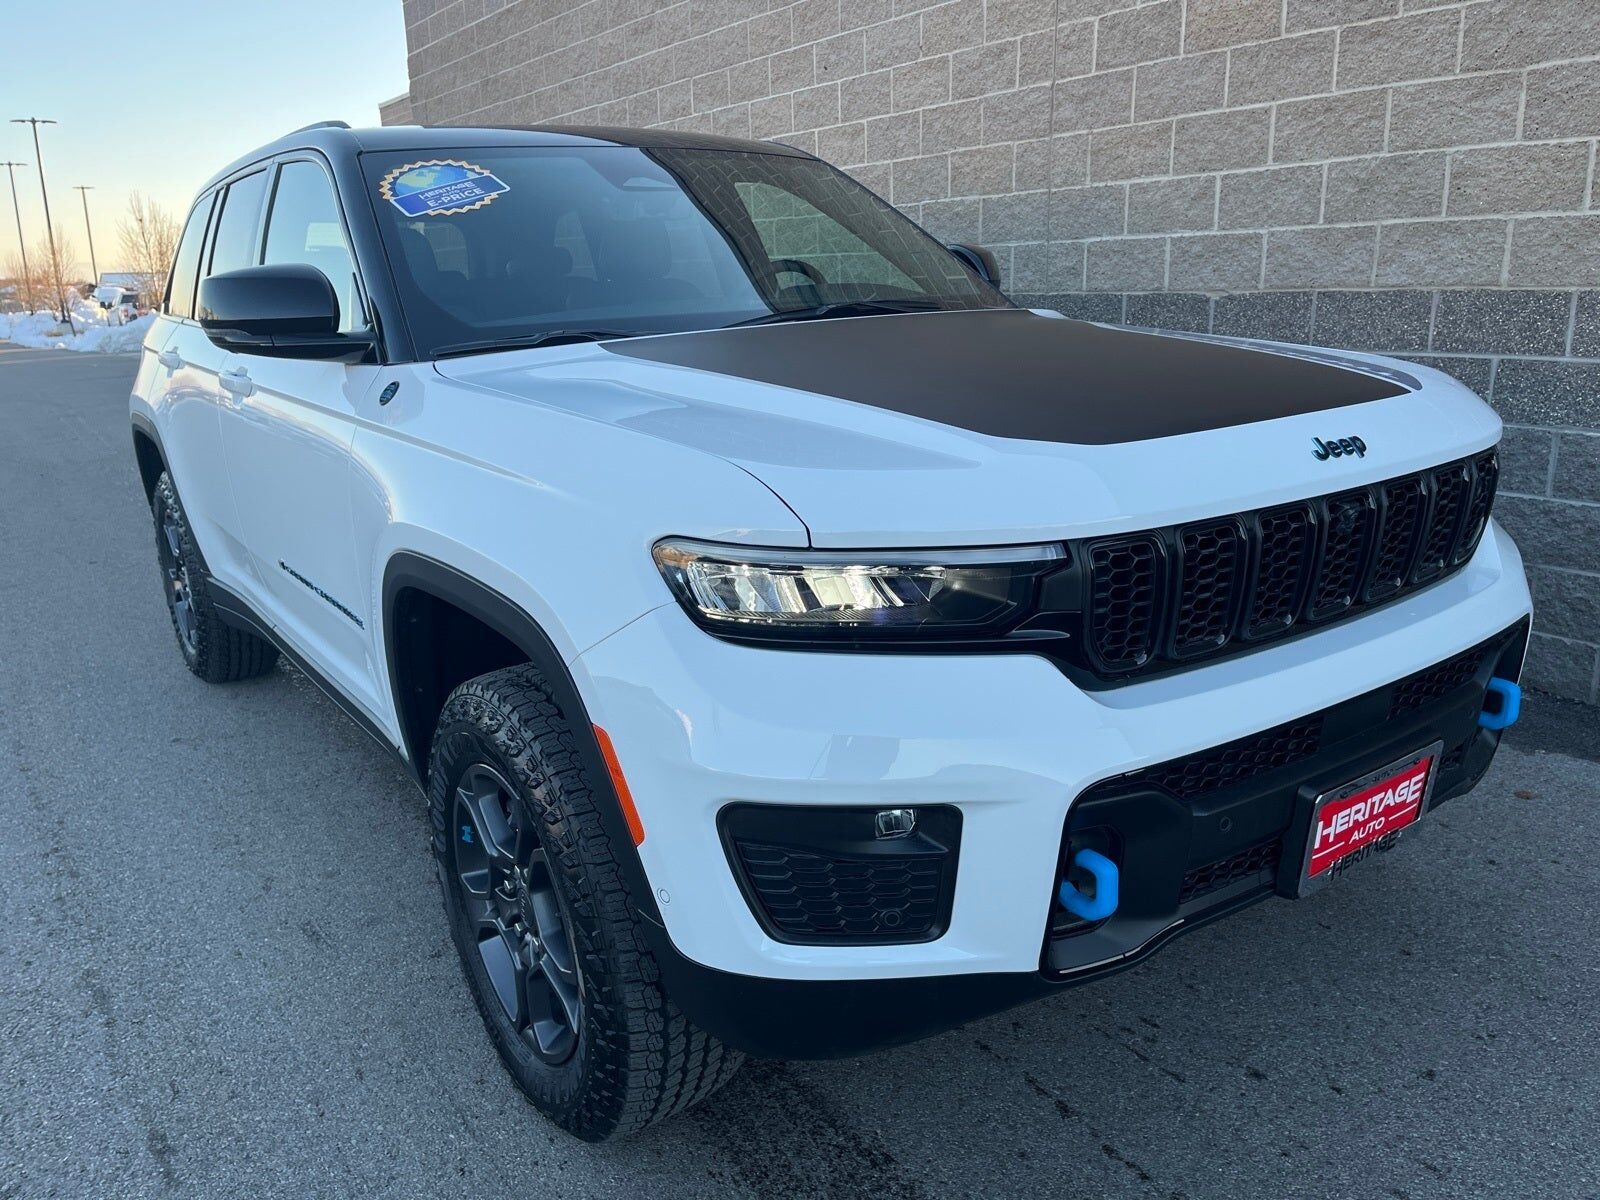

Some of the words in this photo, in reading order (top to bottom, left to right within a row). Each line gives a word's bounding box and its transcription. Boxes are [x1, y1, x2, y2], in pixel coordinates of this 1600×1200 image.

[418, 181, 477, 200] HERITAGE
[427, 187, 485, 207] E-PRICE
[1311, 436, 1367, 461] Jeep
[1314, 771, 1426, 849] HERITAGE
[1349, 816, 1386, 845] AUTO
[1328, 829, 1402, 881] HERITAGE
